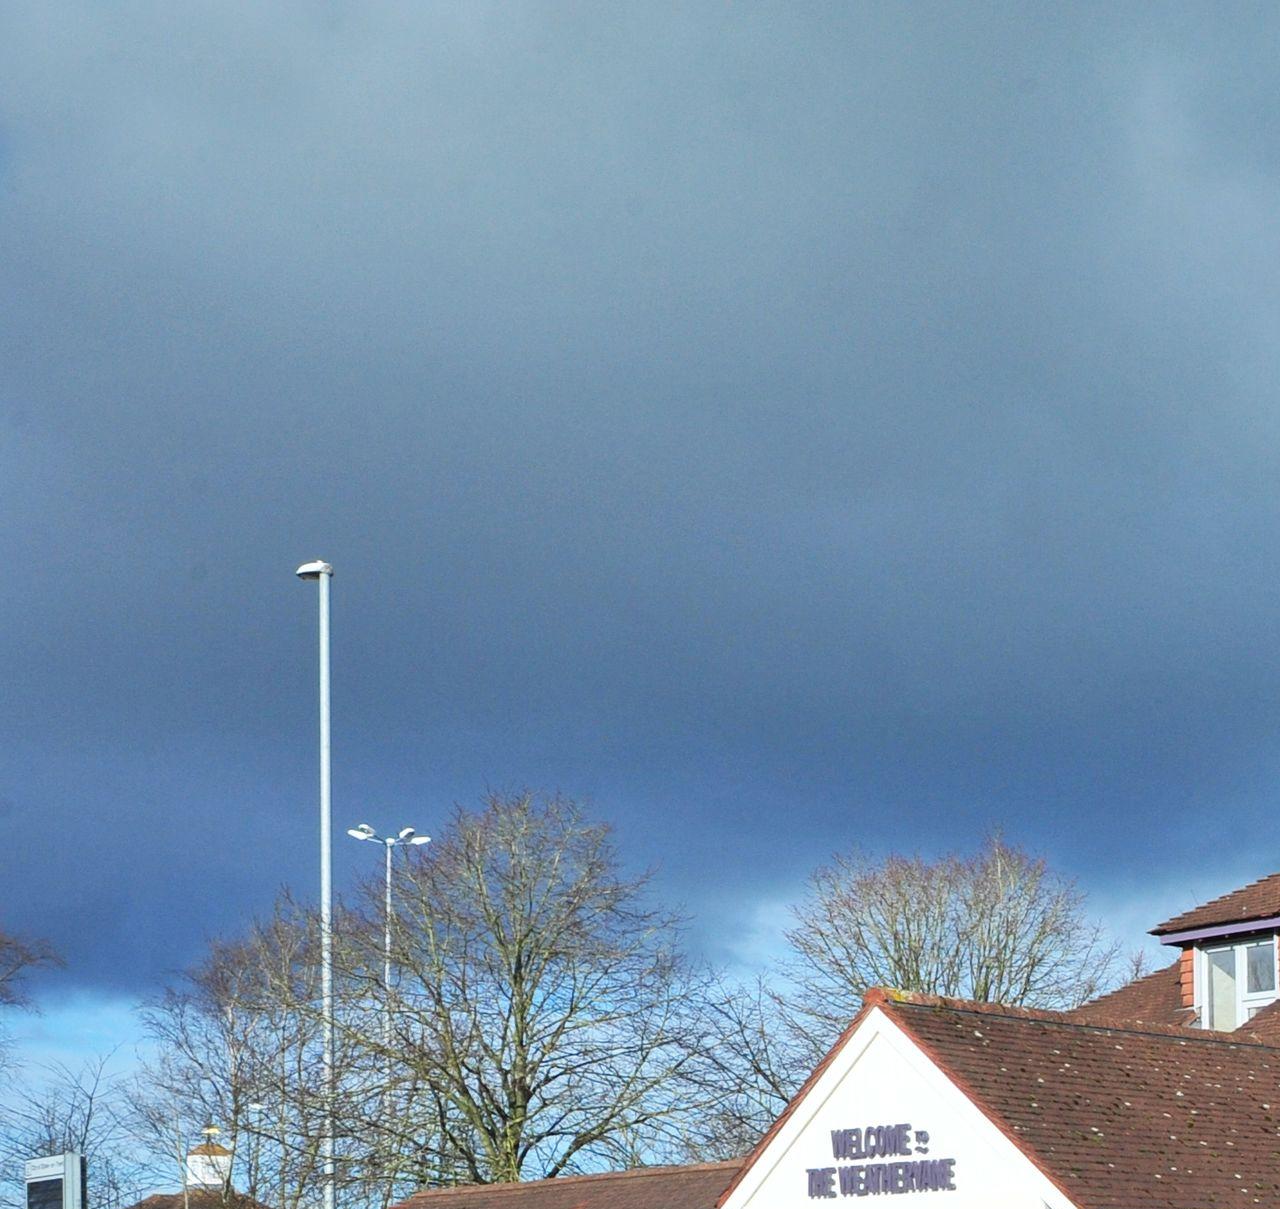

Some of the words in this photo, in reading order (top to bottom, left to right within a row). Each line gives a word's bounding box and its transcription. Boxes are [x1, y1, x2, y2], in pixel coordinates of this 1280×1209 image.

[830, 1123, 912, 1161] WELCOME
[806, 1167, 837, 1199] THE
[838, 1158, 957, 1198] WEATHERVANE
